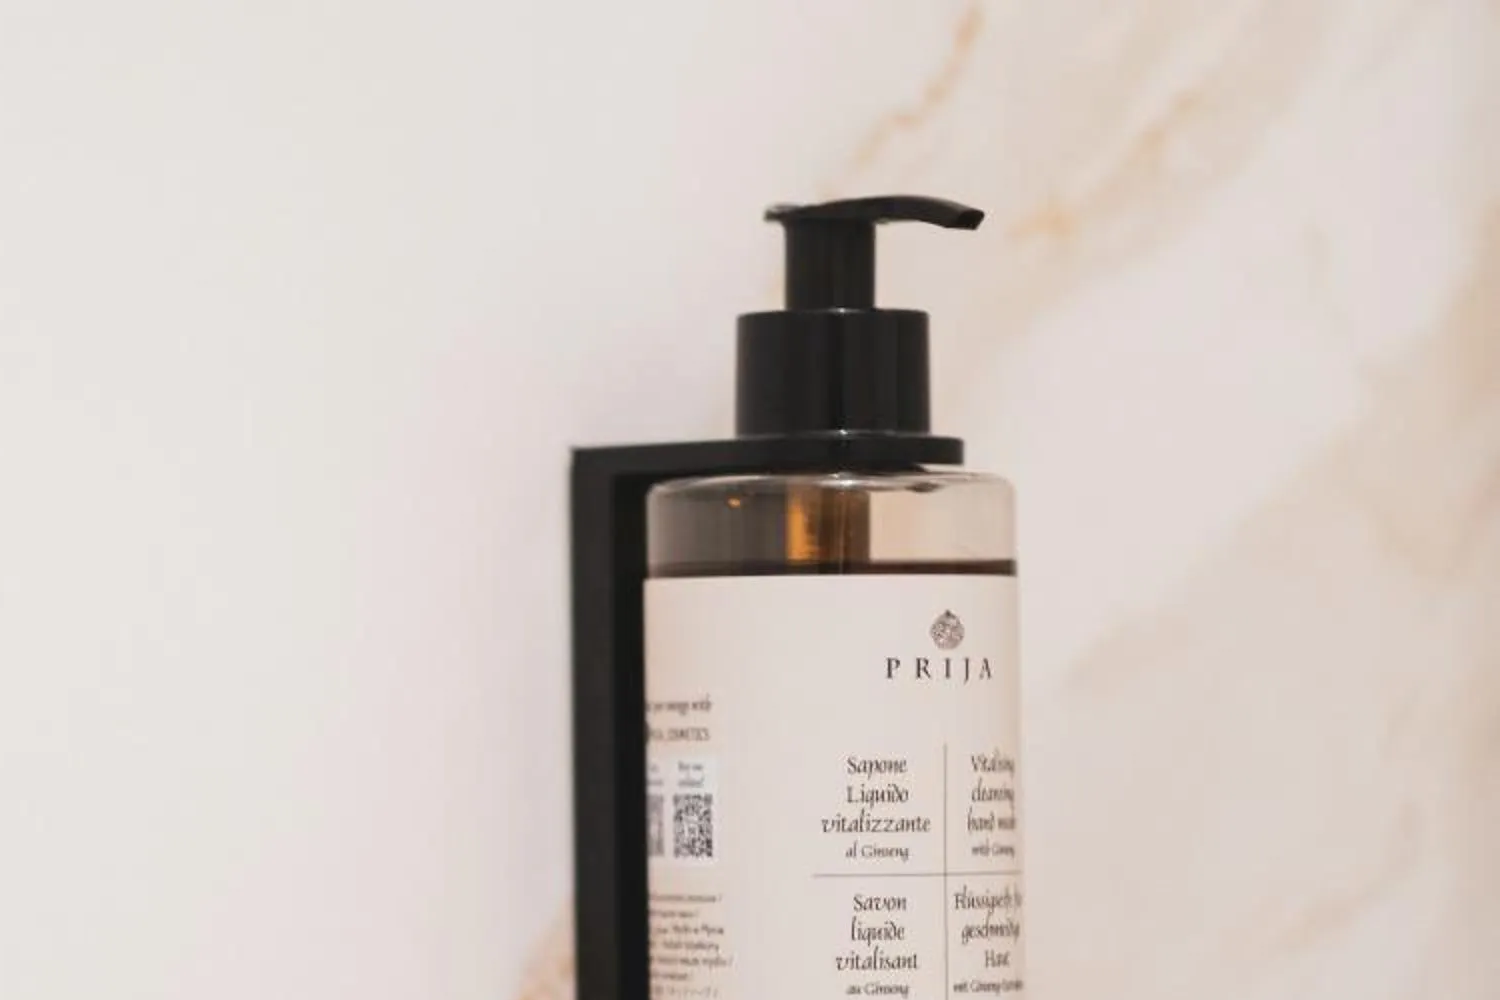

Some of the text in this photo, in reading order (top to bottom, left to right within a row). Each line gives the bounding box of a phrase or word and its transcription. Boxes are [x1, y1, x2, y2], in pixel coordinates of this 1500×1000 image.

[885, 656, 993, 685] PRIJA
[846, 756, 908, 780] Sapone
[846, 783, 909, 808] Liquido
[821, 808, 931, 834] vitalizzante
[845, 840, 857, 858] al
[853, 893, 908, 912] Savon
[851, 916, 906, 945] liquide
[835, 946, 919, 971] vitalisant
